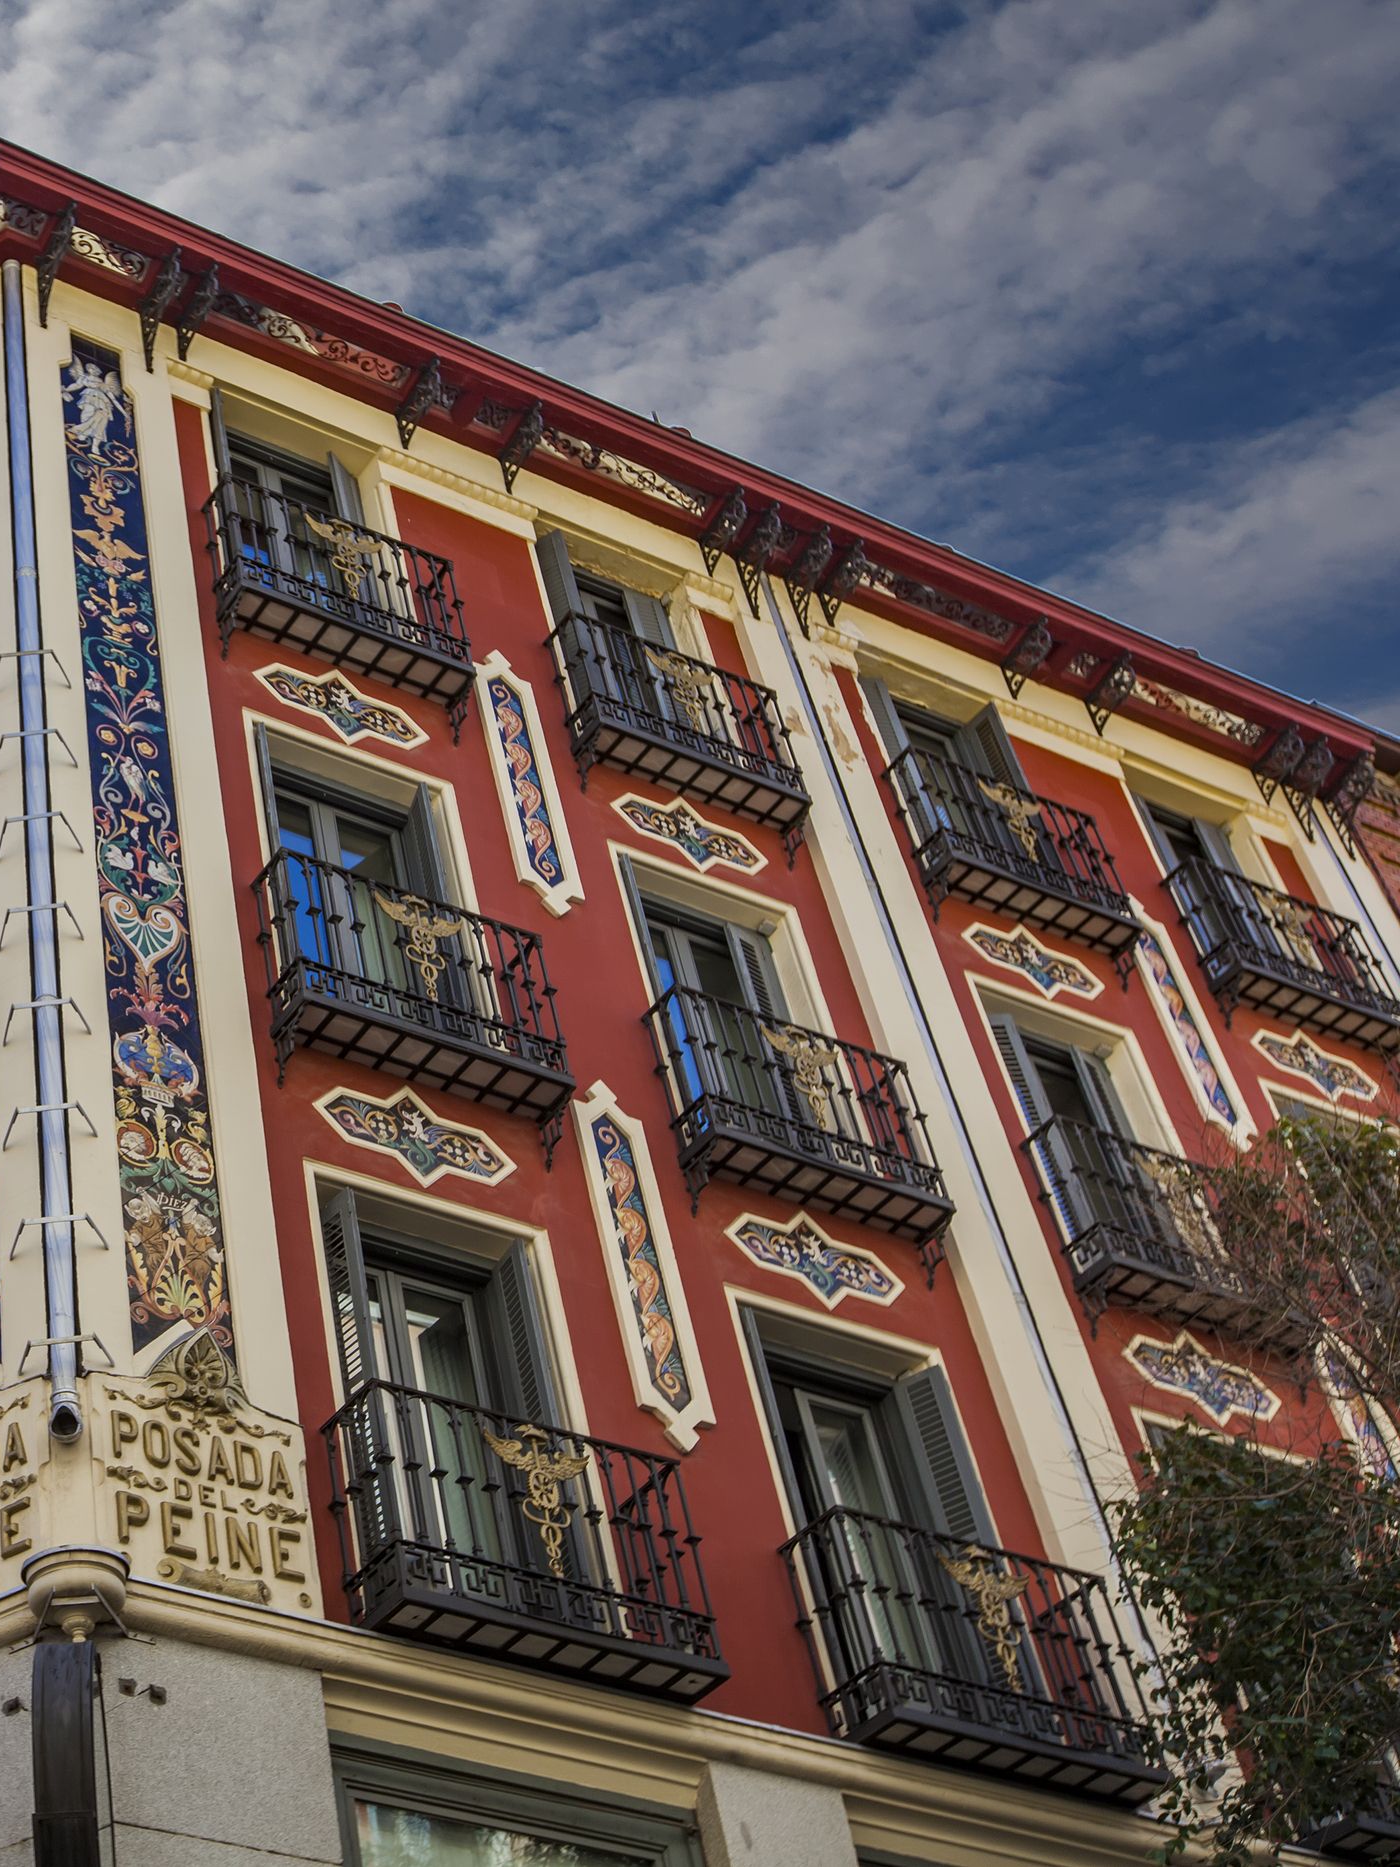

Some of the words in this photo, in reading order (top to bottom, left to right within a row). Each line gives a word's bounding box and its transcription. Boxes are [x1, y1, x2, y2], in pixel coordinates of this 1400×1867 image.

[111, 1410, 294, 1499] POSADA
[174, 1477, 238, 1513] DEL
[117, 1491, 305, 1584] PEINE
